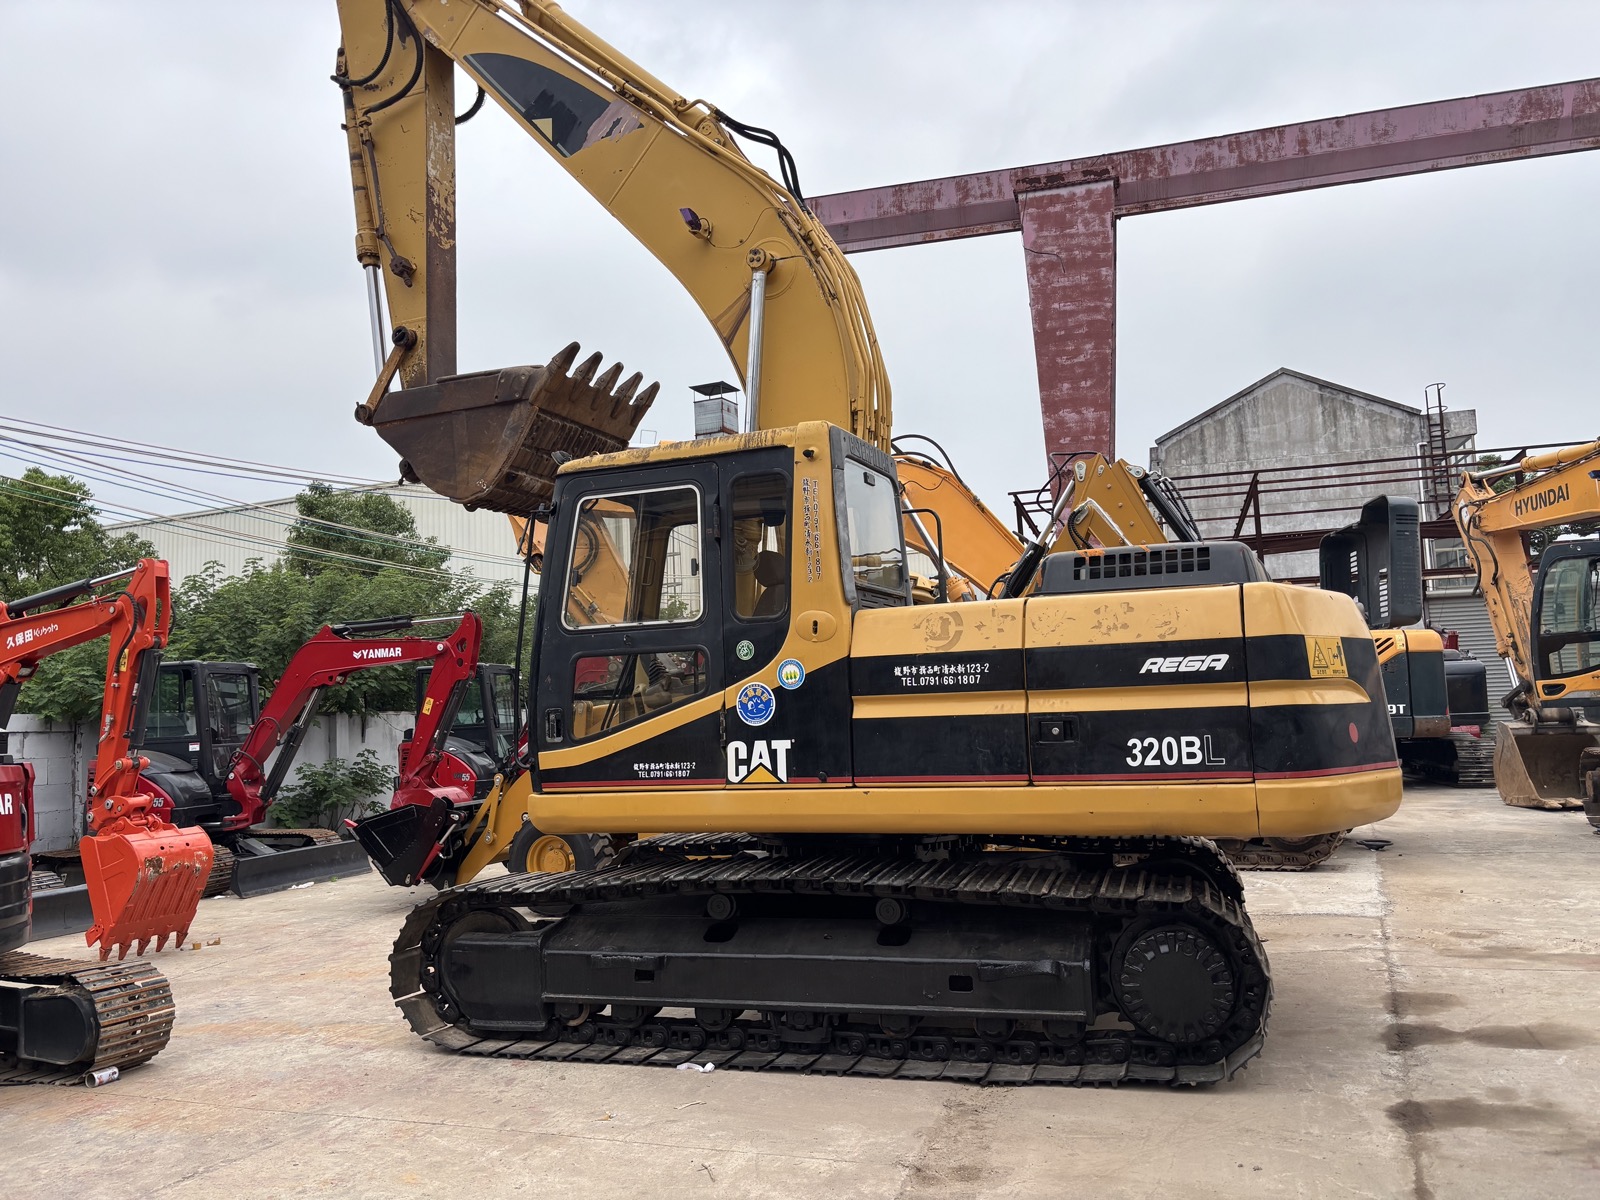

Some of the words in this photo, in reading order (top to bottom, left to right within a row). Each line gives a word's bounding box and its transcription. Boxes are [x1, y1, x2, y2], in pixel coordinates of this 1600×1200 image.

[1514, 483, 1570, 517] HYUNDAI
[6, 629, 34, 650] 久保田
[33, 623, 59, 637] Kubota
[361, 647, 402, 659] YANMAR
[1139, 653, 1230, 674] REGA
[727, 740, 792, 783] CAT
[1125, 734, 1226, 767] 320BL
